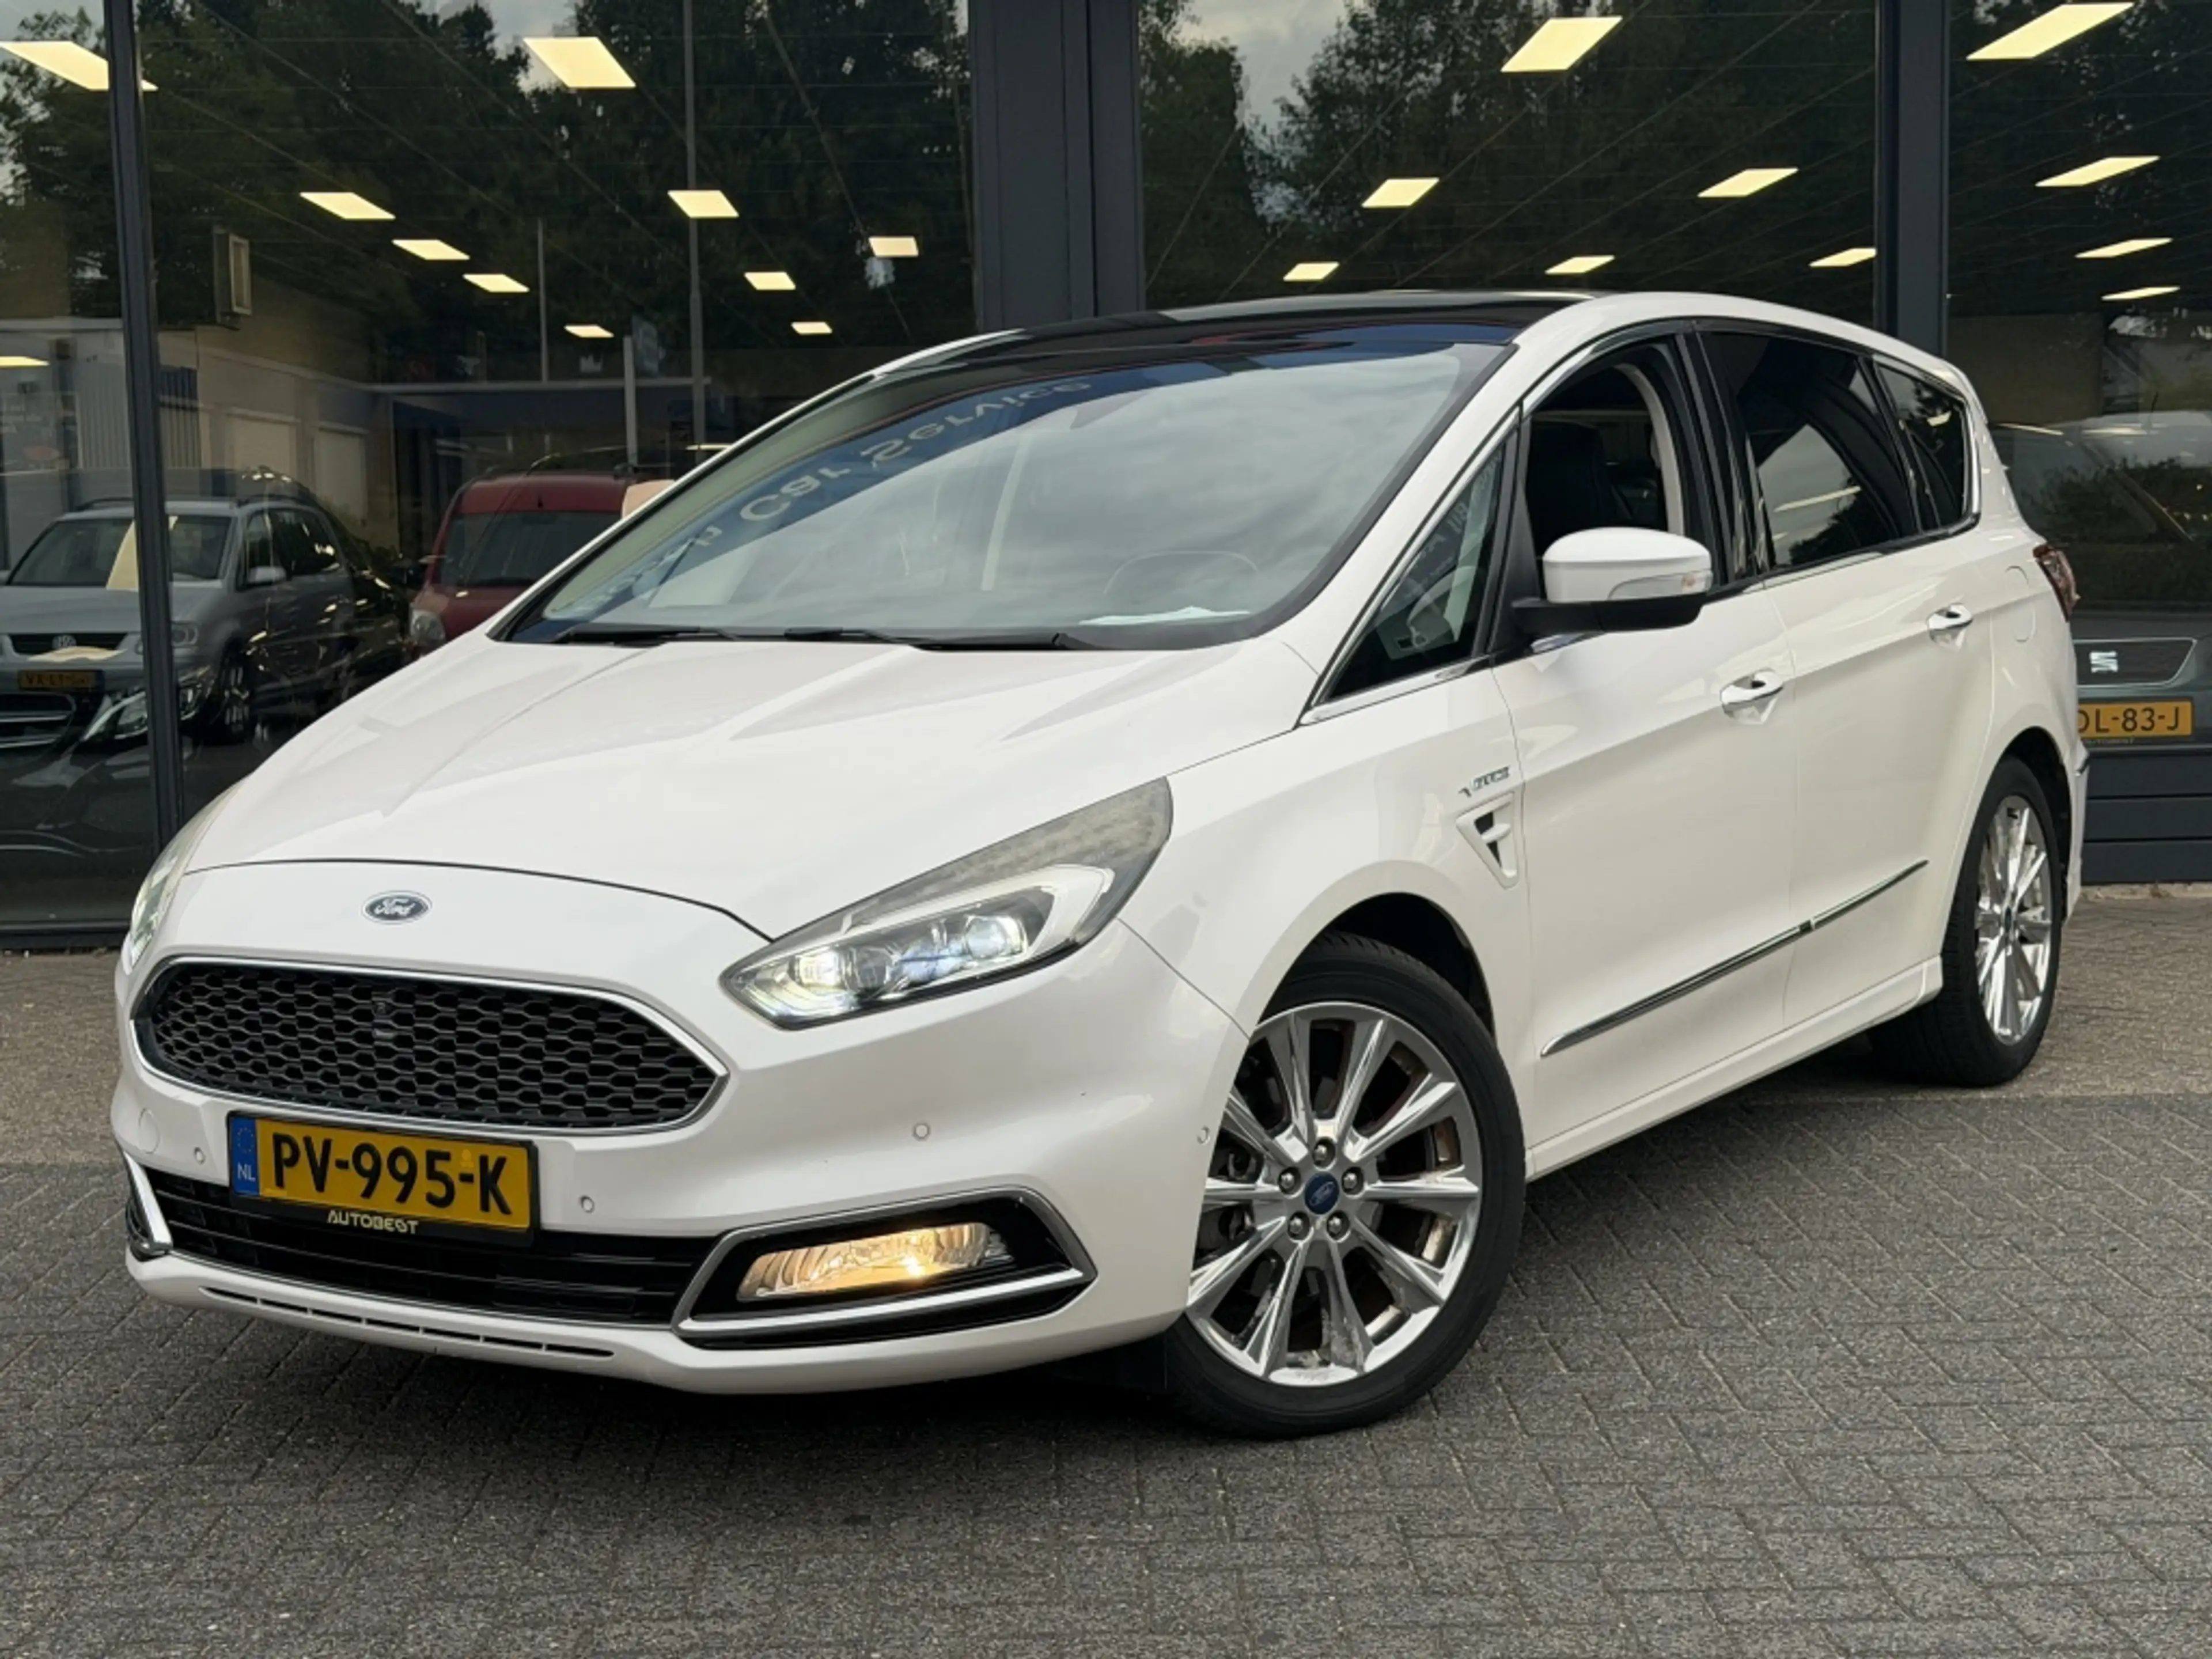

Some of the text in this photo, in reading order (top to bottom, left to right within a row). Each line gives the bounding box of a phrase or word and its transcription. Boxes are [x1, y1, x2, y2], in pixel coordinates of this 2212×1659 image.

[237, 1162, 256, 1182] NL
[272, 1132, 513, 1215] PV-995-K
[327, 1209, 419, 1234] AUTOBEST
